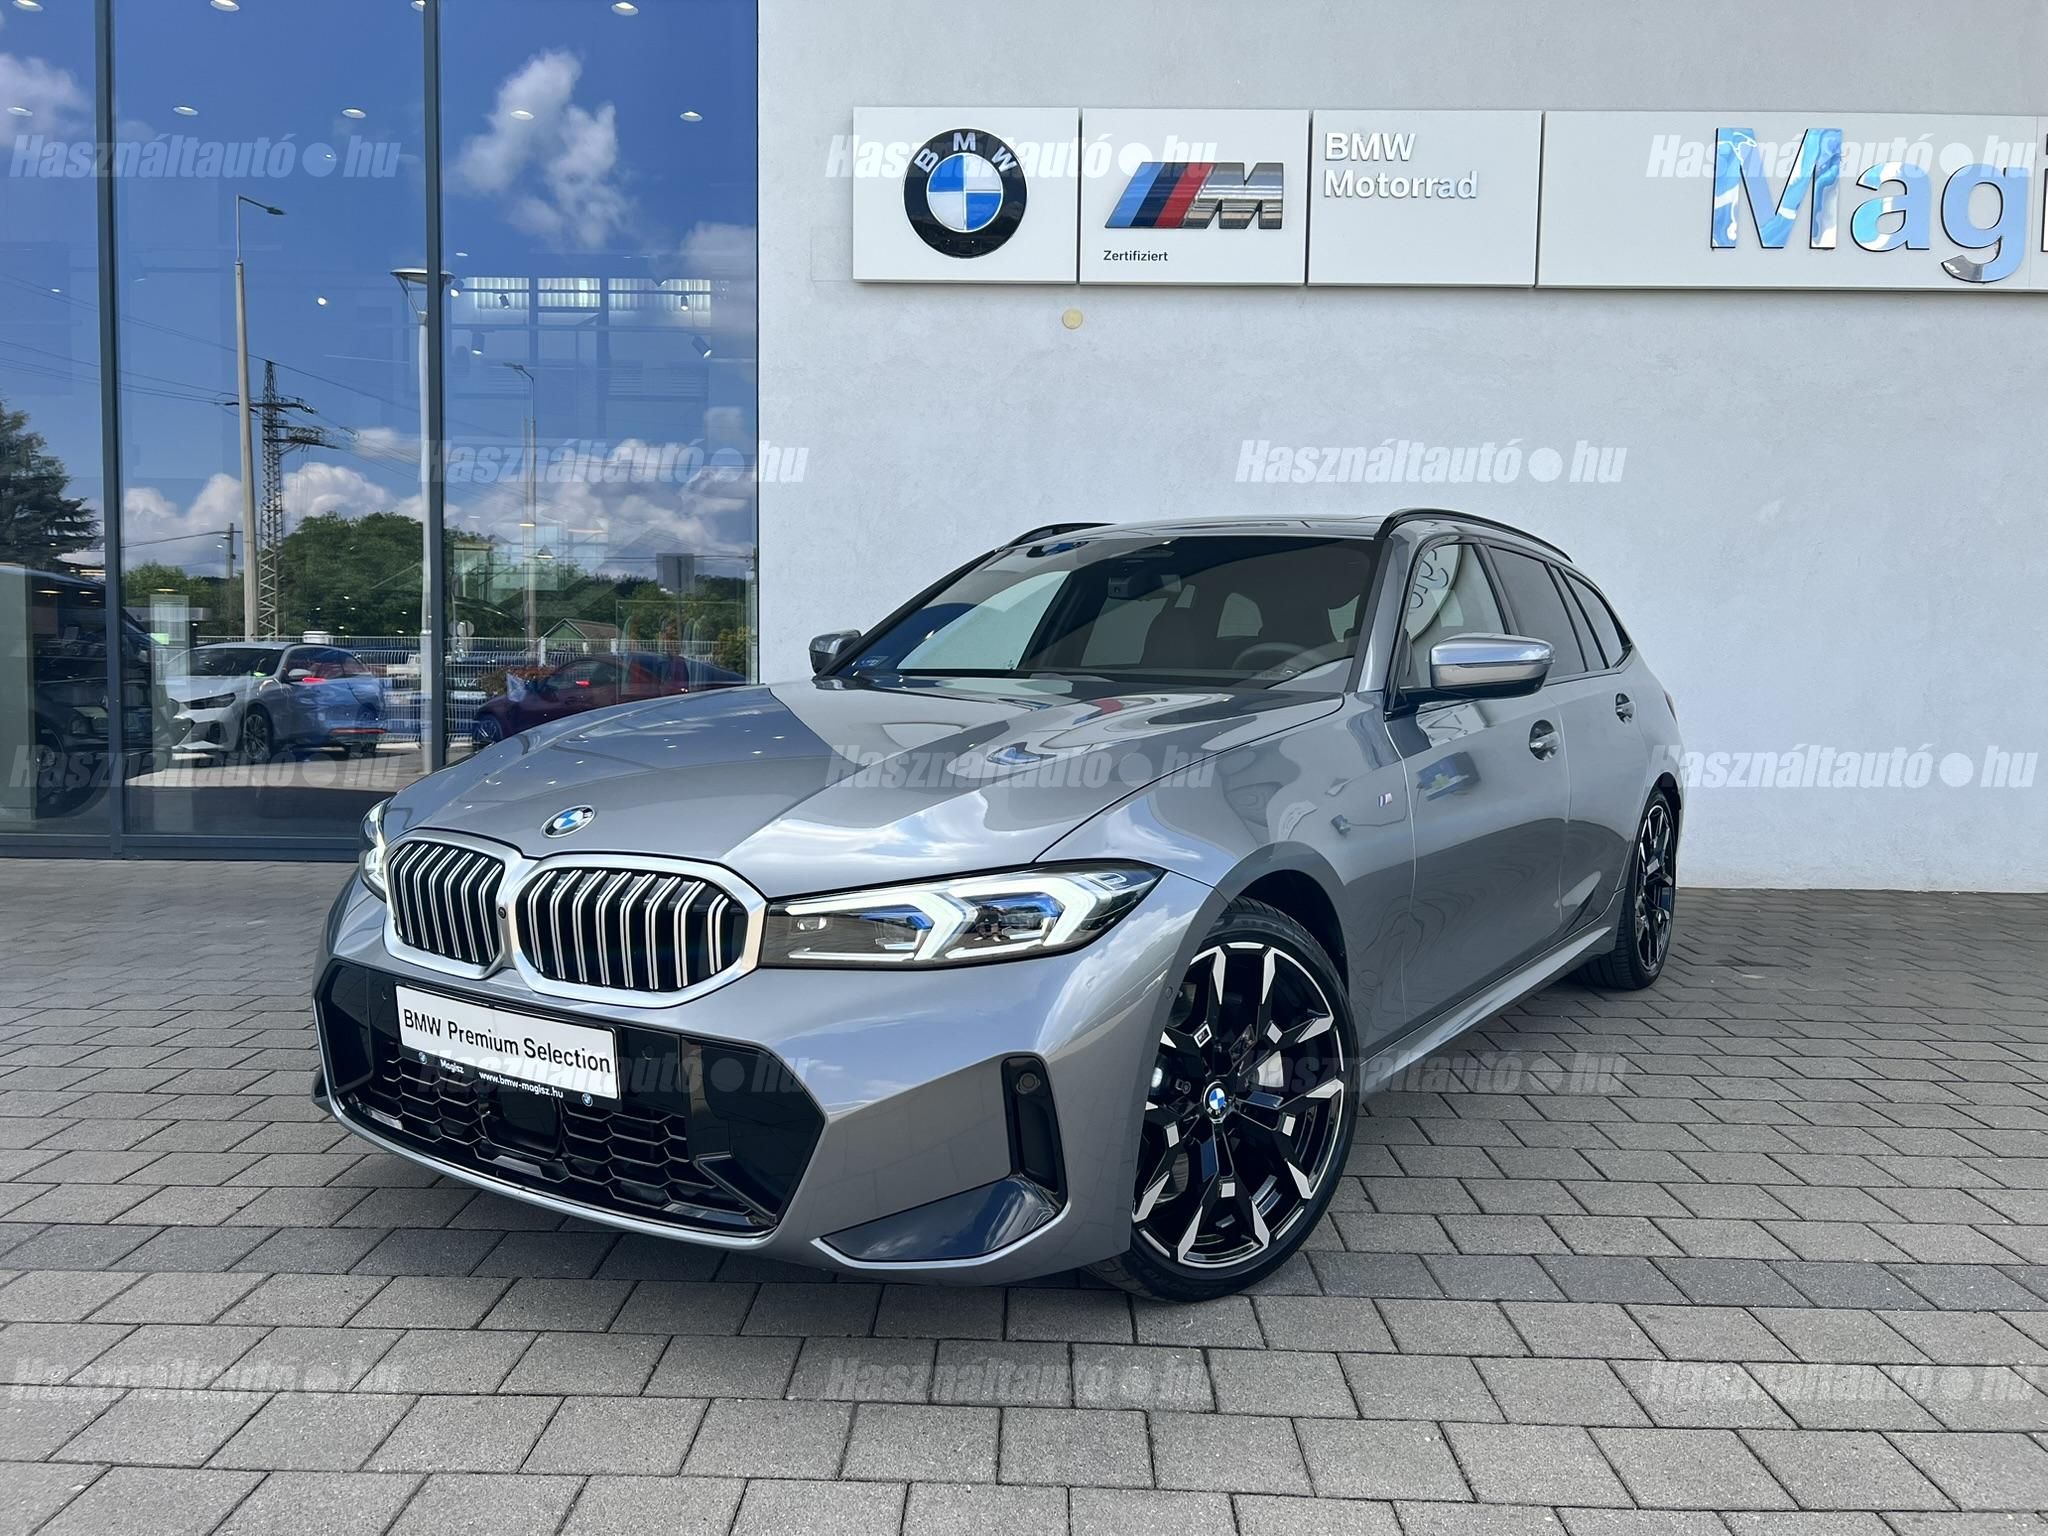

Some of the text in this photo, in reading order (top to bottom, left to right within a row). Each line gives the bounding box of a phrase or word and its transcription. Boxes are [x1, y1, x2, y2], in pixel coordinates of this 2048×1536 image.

[914, 132, 1018, 173] BMW
[1324, 132, 1415, 162] BMW
[1324, 170, 1478, 200] Motorrad
[1103, 249, 1168, 263] Zertifiziert
[404, 1008, 610, 1074] BMW Premium Selection
[440, 1058, 464, 1074] Magisz
[478, 1070, 564, 1099] www.bmw-magisz.hu
